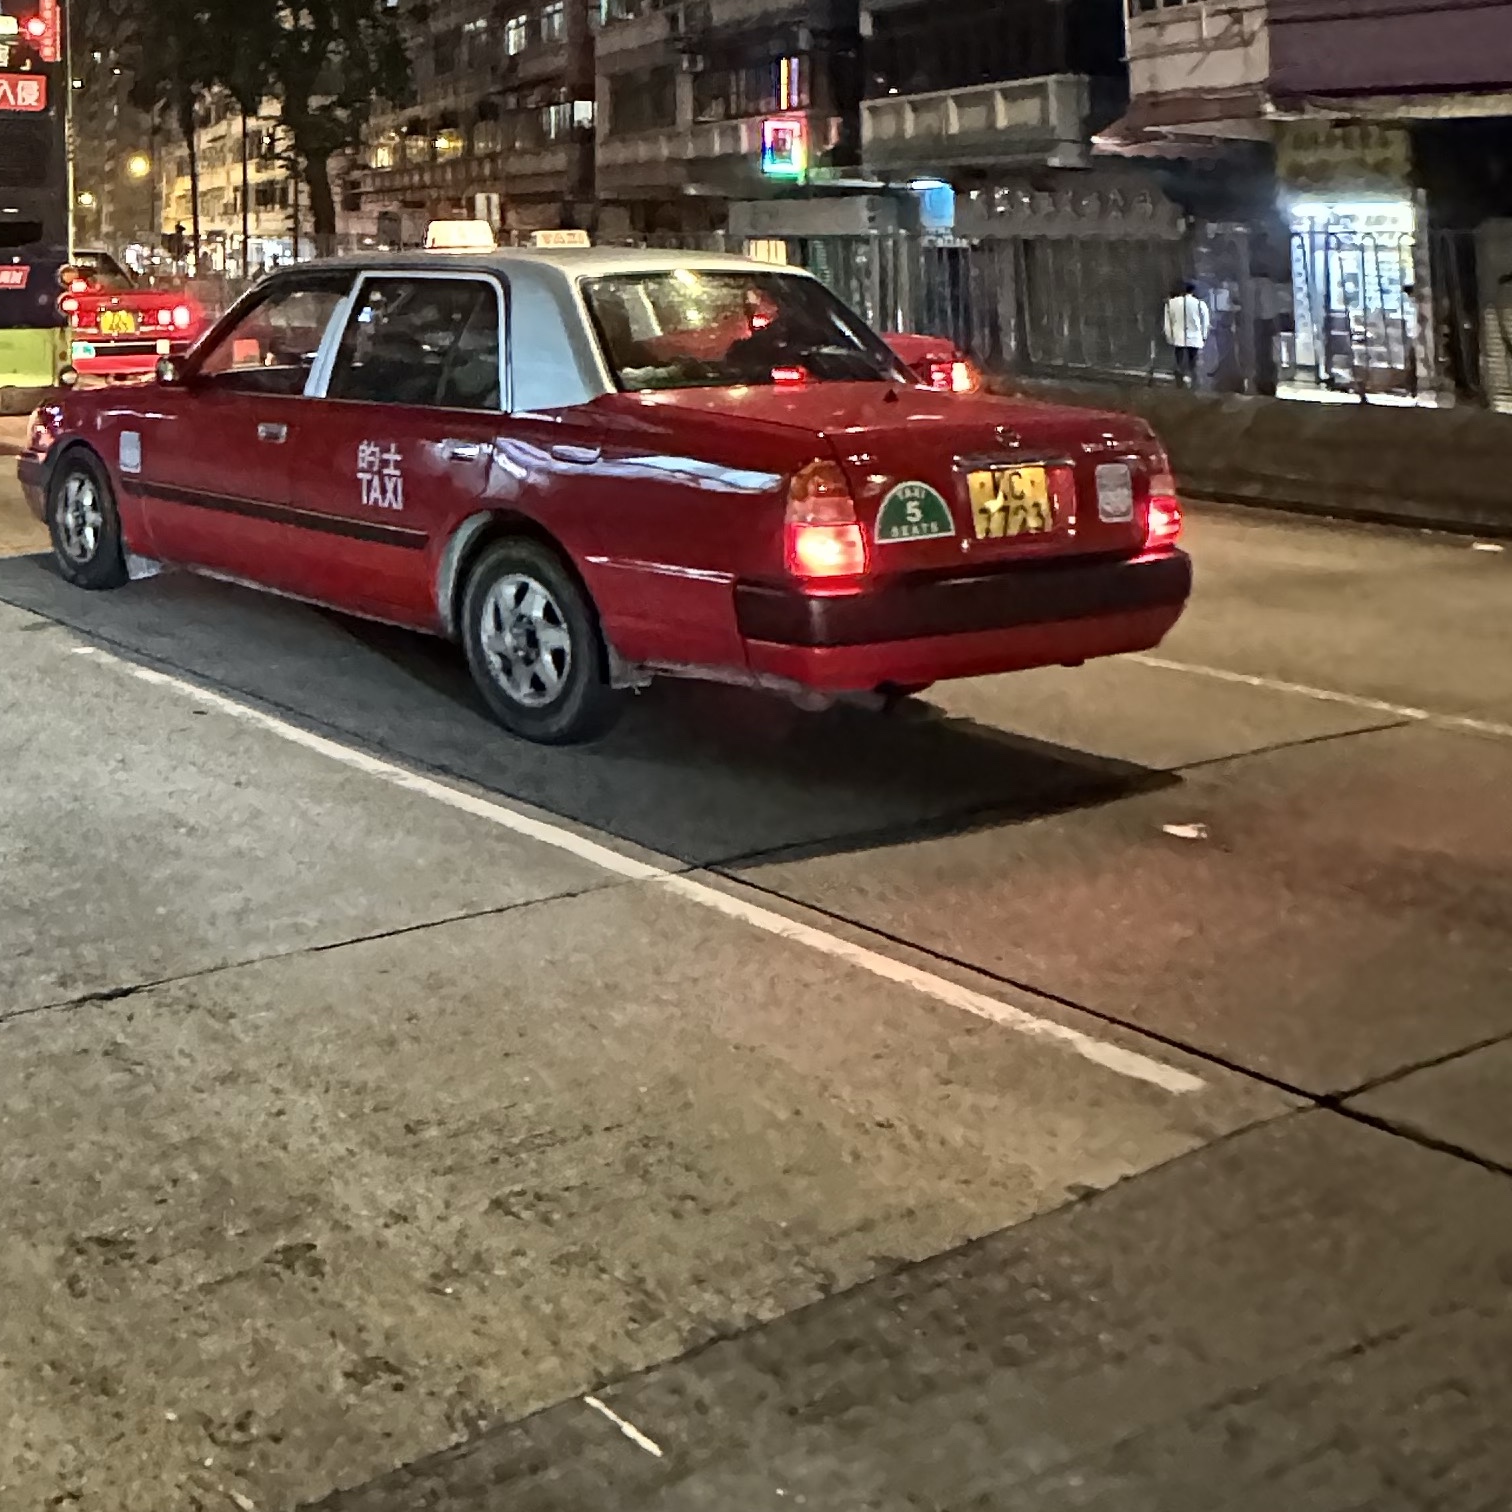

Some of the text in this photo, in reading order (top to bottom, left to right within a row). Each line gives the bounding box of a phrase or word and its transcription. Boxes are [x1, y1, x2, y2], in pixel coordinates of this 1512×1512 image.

[357, 439, 403, 475] 的士
[356, 472, 403, 510] TAXI
[906, 500, 923, 522] 5
